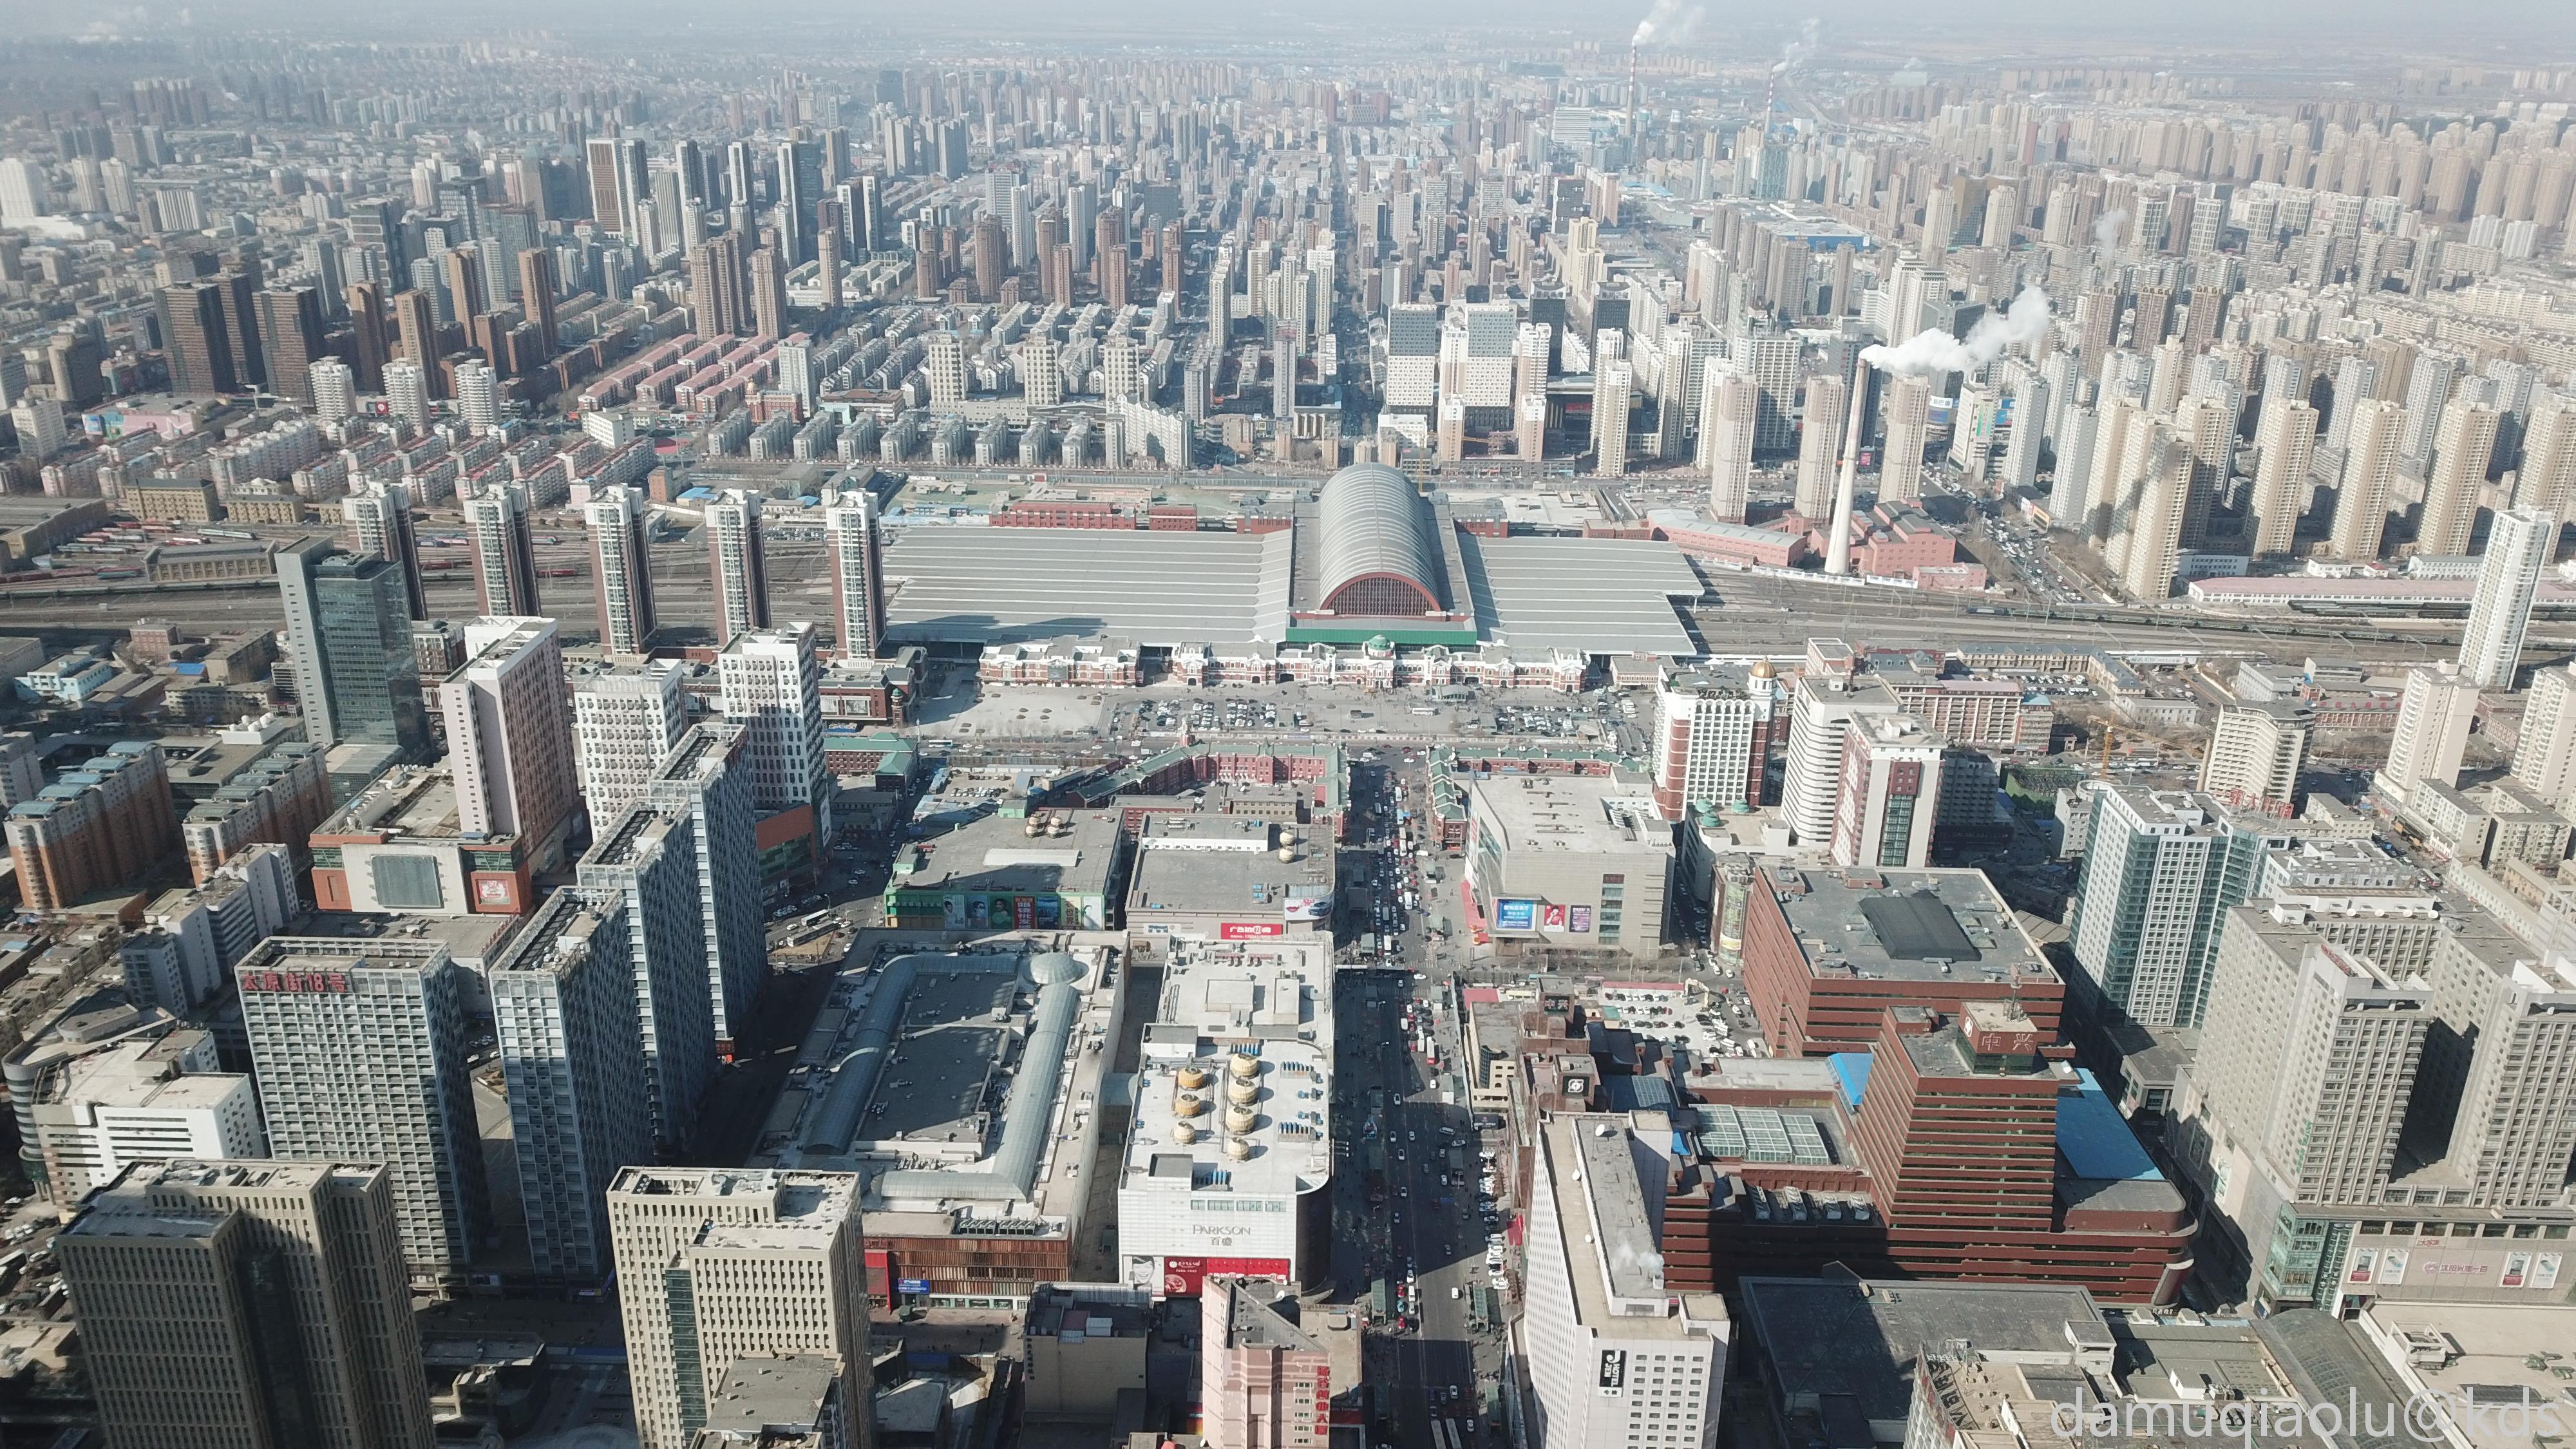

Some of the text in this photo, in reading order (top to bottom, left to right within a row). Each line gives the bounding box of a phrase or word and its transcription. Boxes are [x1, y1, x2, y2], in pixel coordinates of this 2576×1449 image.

[242, 971, 348, 993] 太原街18号
[1545, 999, 1569, 1010] 中兴
[1981, 1033, 2034, 1051] 中兴
[1193, 1224, 1251, 1235] PARKSON
[1211, 1236, 1233, 1246] 百盛
[1604, 1363, 1613, 1378] JEN
[1611, 1363, 1620, 1387] HOTEL
